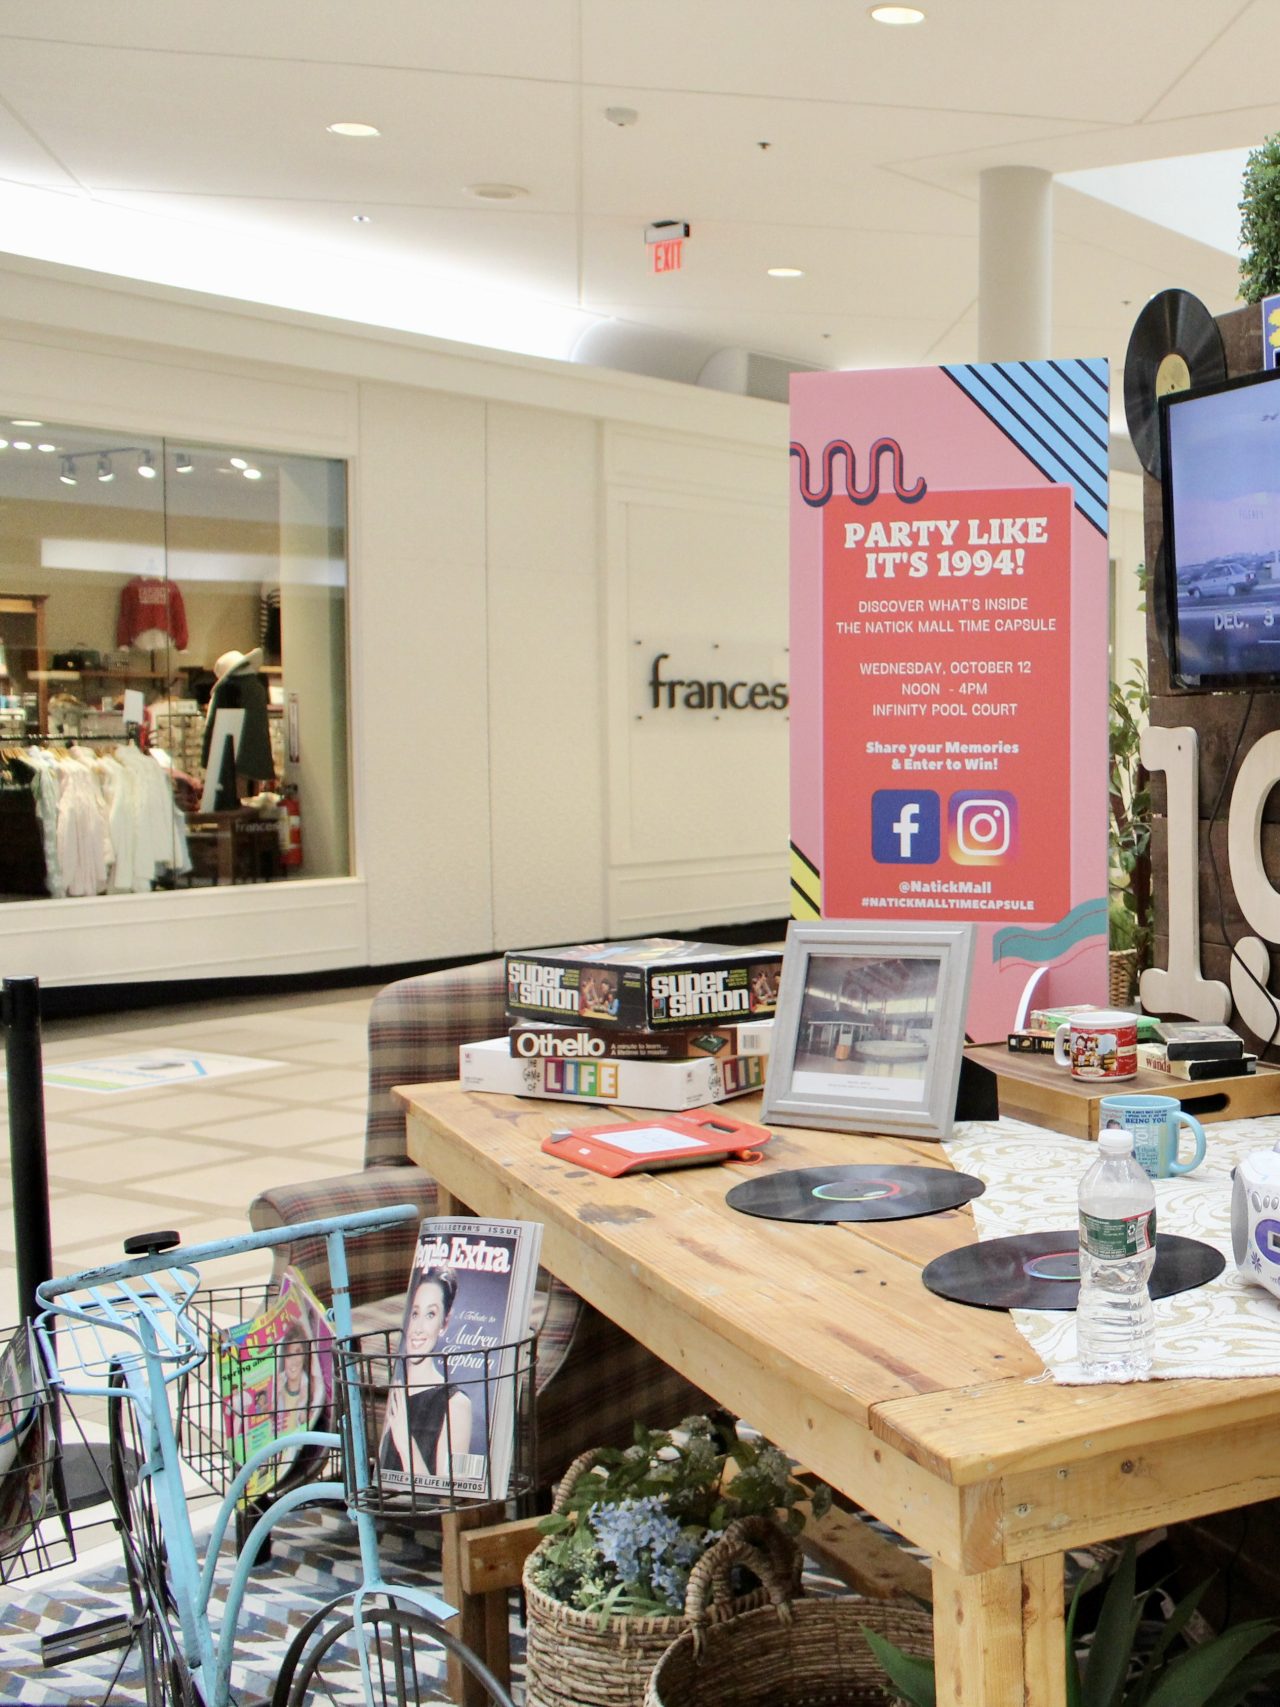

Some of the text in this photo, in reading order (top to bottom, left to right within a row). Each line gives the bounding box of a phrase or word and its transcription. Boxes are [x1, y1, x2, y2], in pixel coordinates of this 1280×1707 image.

[653, 239, 683, 273] EXIT
[844, 517, 1048, 548] PARTY LIKE
[865, 549, 1025, 578] IT'S 1994!
[858, 597, 1028, 613] DISCOVER WHAT'S INSIDE
[836, 618, 1056, 635] THE NATICK MALL TIME CAPSULE
[1214, 611, 1249, 631] DEC.
[1263, 608, 1275, 627] 3
[860, 661, 1031, 676] WEDNESDAY, OCTOBER 12
[648, 653, 788, 710] frances
[902, 683, 940, 695] NOON
[959, 682, 988, 695] 4PM
[872, 703, 1018, 716] INFINITY POOL COURT
[866, 740, 1019, 757] Share your Memories
[891, 758, 998, 770] & Enter to Win!
[899, 880, 992, 894] @NatickMall
[861, 897, 1035, 911] #NATICKMALLTIMECAPSULE
[508, 963, 565, 990] super
[651, 970, 728, 999] super
[520, 982, 579, 1011] simon
[670, 988, 749, 1018] simon
[516, 1032, 605, 1057] Othello
[546, 1062, 616, 1094] LIFE
[724, 1057, 764, 1091] LIF
[1146, 1058, 1172, 1074] wanda
[488, 1226, 519, 1236] ISSUE
[416, 1236, 511, 1274] eople Extra
[446, 1324, 498, 1349] Audrey
[389, 1473, 403, 1483] STYLE
[424, 1478, 440, 1487] LIFE
[442, 1480, 450, 1488] IN
[452, 1481, 483, 1491] PHOTOS
